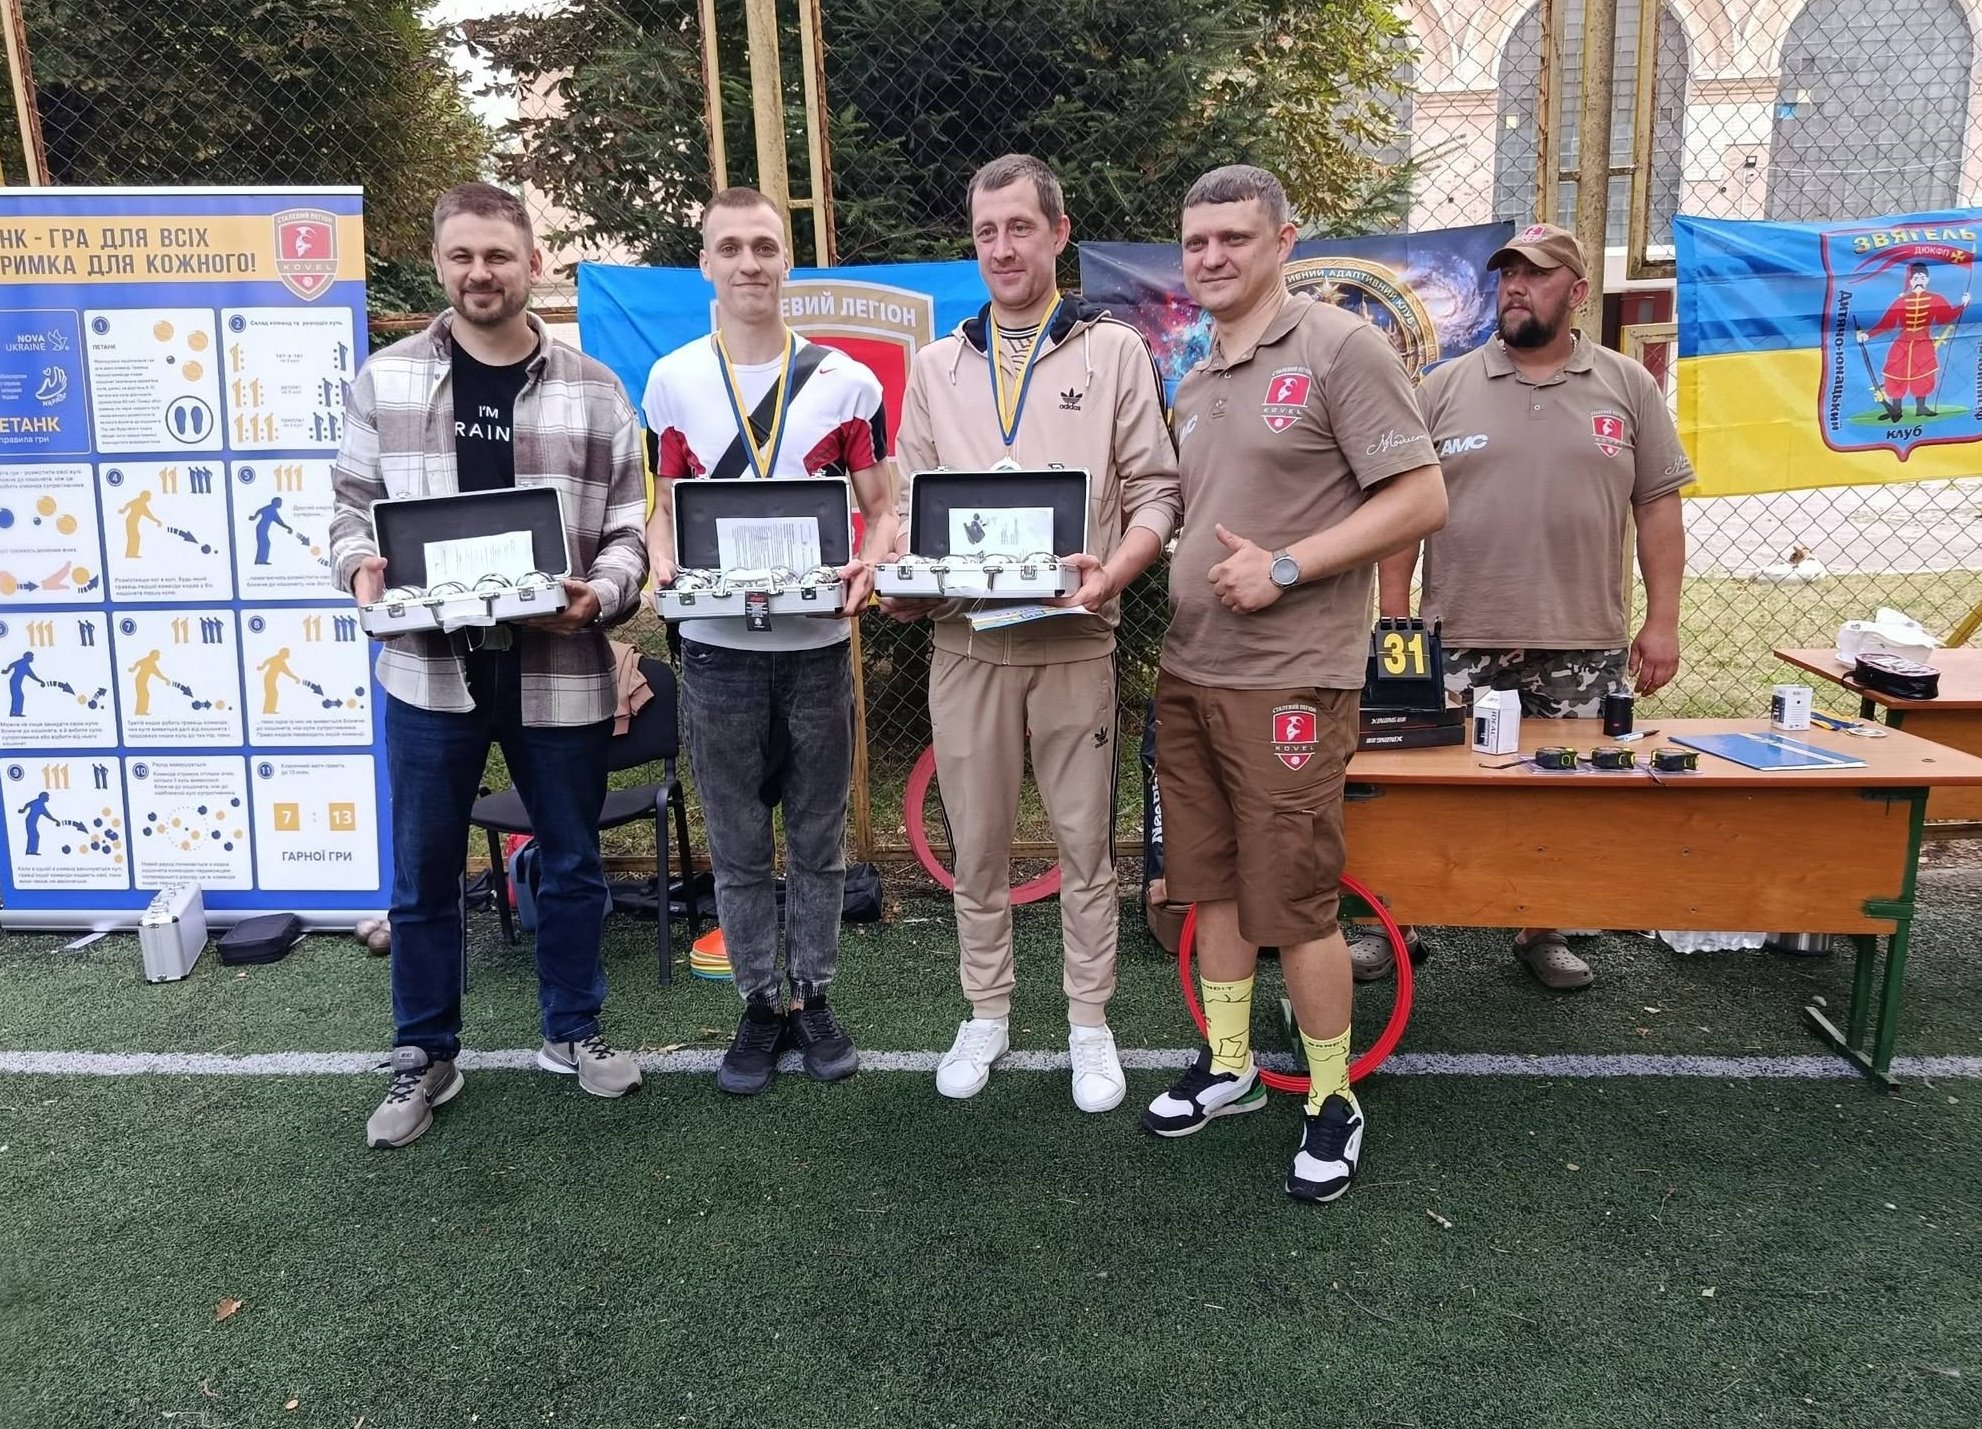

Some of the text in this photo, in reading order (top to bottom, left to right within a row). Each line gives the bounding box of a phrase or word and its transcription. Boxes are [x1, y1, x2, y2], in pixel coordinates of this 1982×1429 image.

[49, 229, 89, 249] ГРА
[101, 228, 148, 250] ДЛЯ
[160, 228, 209, 248] ВСІХ
[1854, 228, 1976, 254] ЗВЯГЕЛЬ
[88, 255, 135, 277] ДЛЯ
[147, 253, 256, 273] КОЖНОГО!
[841, 298, 916, 327] ЛЕГІОН
[6, 343, 46, 352] UKRAINE
[17, 334, 45, 343] NOVA
[1886, 425, 1923, 441] клуб
[1440, 434, 1488, 457] AMC
[1383, 632, 1425, 674] 31
[282, 811, 292, 824] 7
[333, 811, 352, 824] 13
[282, 850, 352, 861] ГАРНОЇ ГРИ
